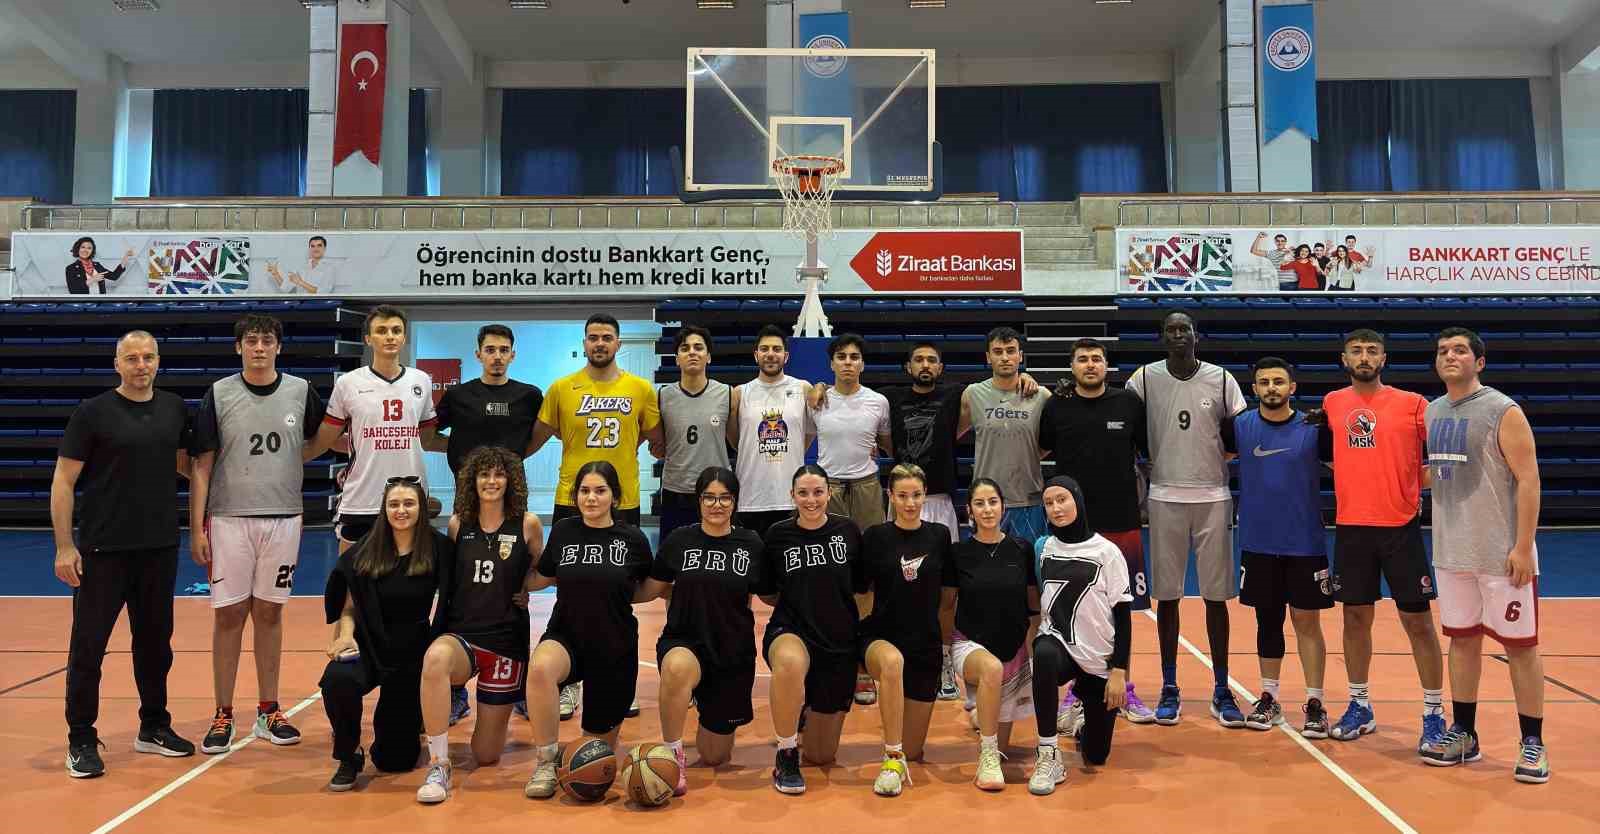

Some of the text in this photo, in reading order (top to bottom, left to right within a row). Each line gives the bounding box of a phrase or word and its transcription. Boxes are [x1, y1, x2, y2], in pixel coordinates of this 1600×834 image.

[416, 243, 770, 267] Öğrencinin dostu Bankkart Genç,
[897, 255, 1016, 272] Ziraat Bankası
[1408, 247, 1510, 262] BANKKART
[419, 268, 767, 286] hem banka kartı hem kredi kartı!
[1386, 266, 1465, 284] HARÇLIK
[1470, 266, 1531, 282] AVANS
[383, 399, 404, 421] 13
[576, 394, 632, 416] LAKERS
[985, 407, 1030, 420] 76ers
[1178, 410, 1191, 430] 9
[586, 416, 621, 448] 23
[687, 425, 698, 445] 6
[1348, 434, 1376, 448] MSK
[249, 431, 282, 456] 20
[374, 438, 411, 450] KOLEJİ
[760, 443, 787, 451] COURT
[559, 539, 629, 566] ERÜ
[681, 548, 750, 576] ERÜ
[784, 535, 847, 573] ERÜ
[473, 559, 495, 584] 13
[1040, 554, 1104, 646] 7
[1504, 600, 1522, 623] 6
[492, 656, 513, 680] 13
